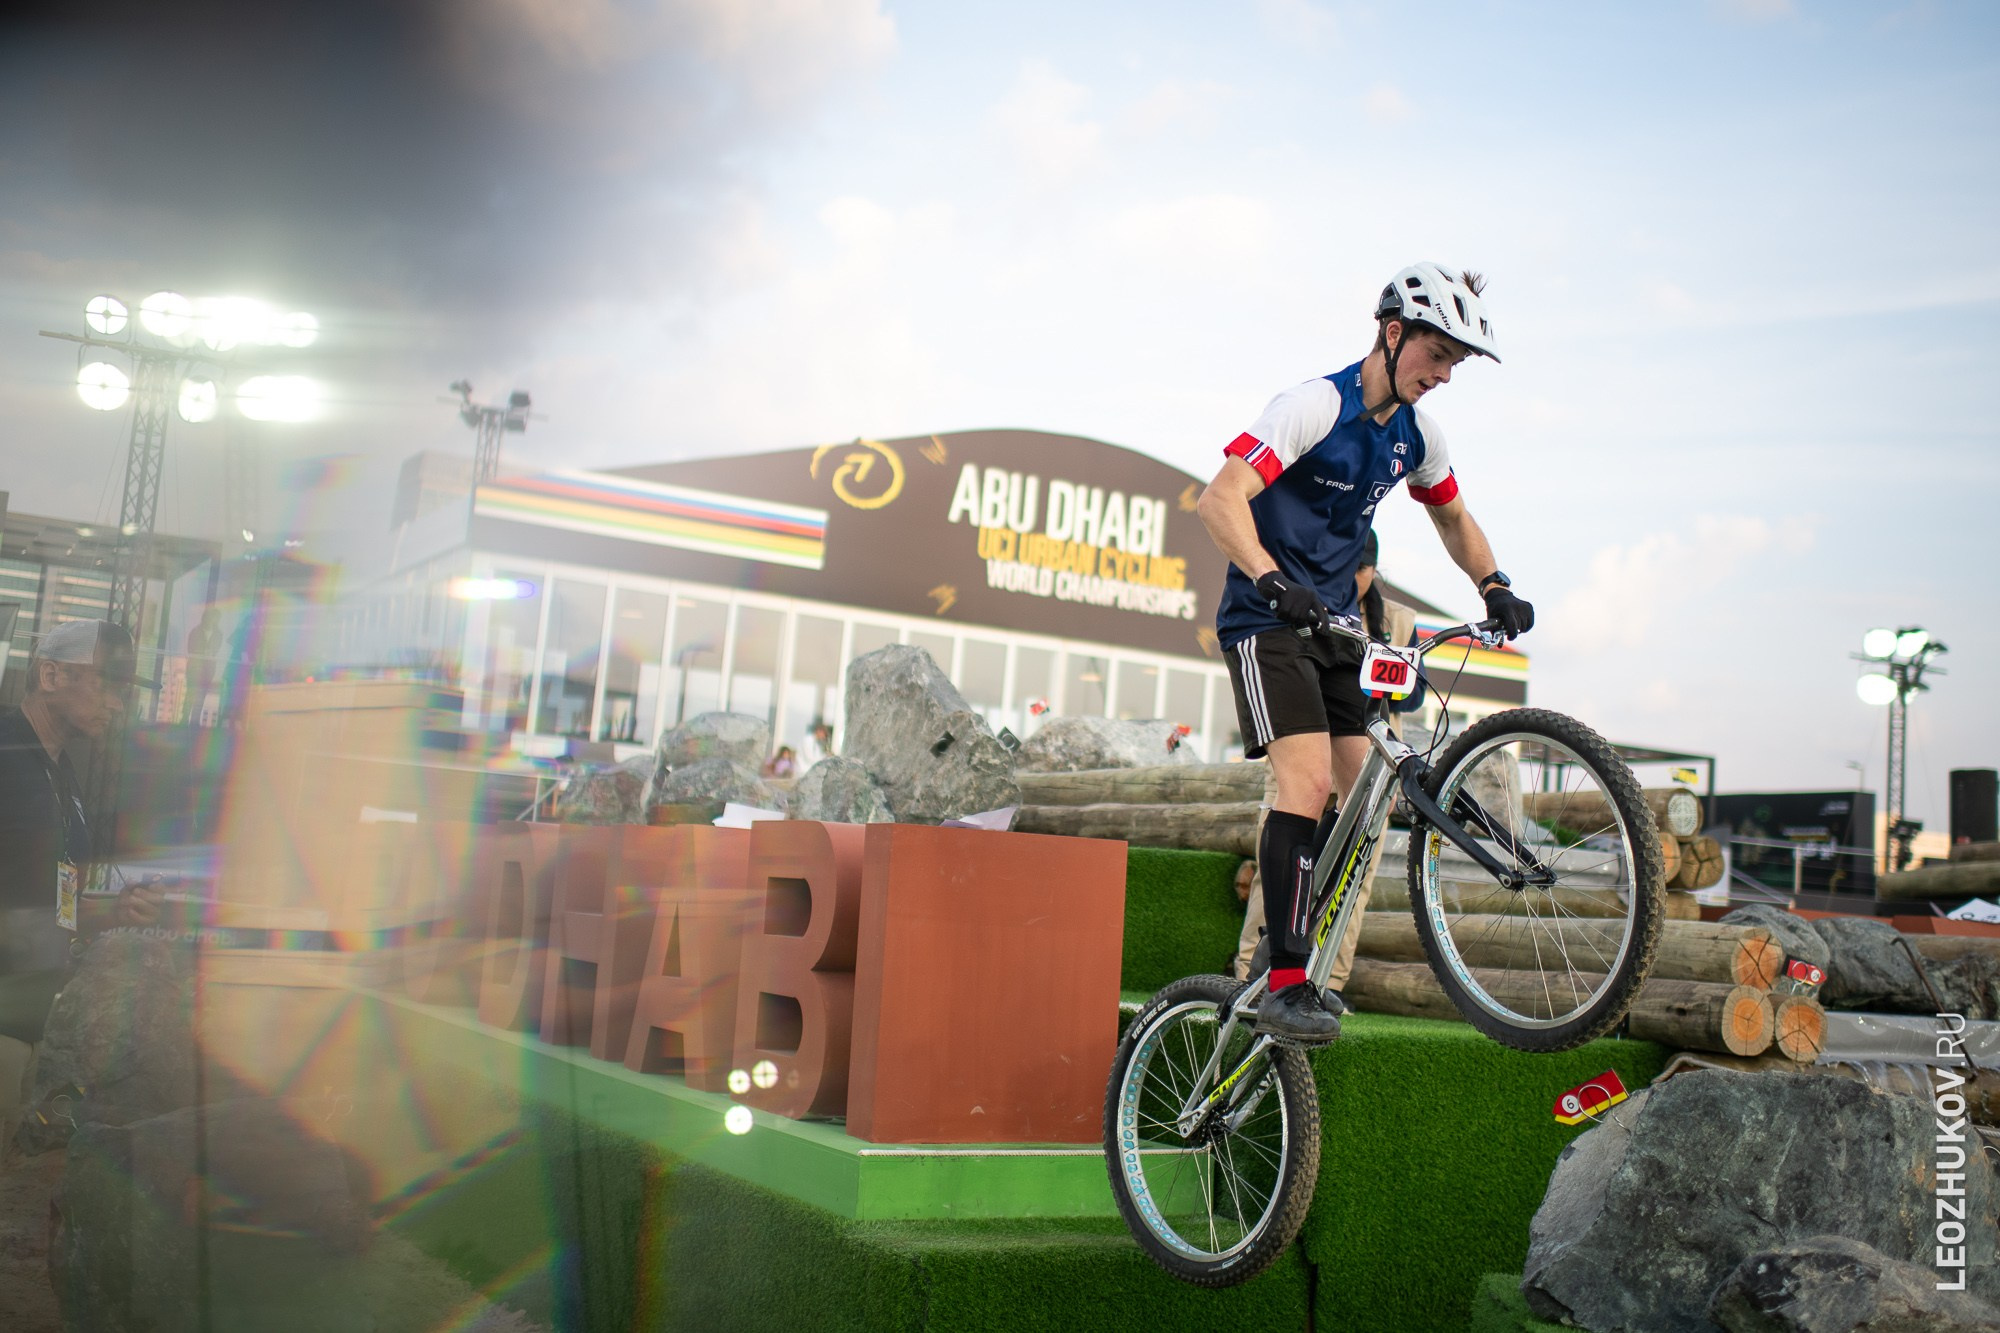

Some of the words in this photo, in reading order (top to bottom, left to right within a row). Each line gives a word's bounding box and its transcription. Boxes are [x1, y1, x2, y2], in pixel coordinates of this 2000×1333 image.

[1435, 302, 1451, 330] hebo
[948, 463, 1039, 534] ABU
[1046, 479, 1167, 557] DHABI
[977, 525, 1017, 561] UCI
[1018, 532, 1098, 577] URBAN
[1099, 546, 1187, 591] CYCLING
[987, 558, 1054, 598] WORLD
[1055, 570, 1197, 620] CHAMPIONSHIPS
[1375, 662, 1405, 685] 201
[1316, 831, 1373, 950] COMAS
[1131, 1021, 1144, 1040] VEE
[1142, 1006, 1158, 1026] TIRE
